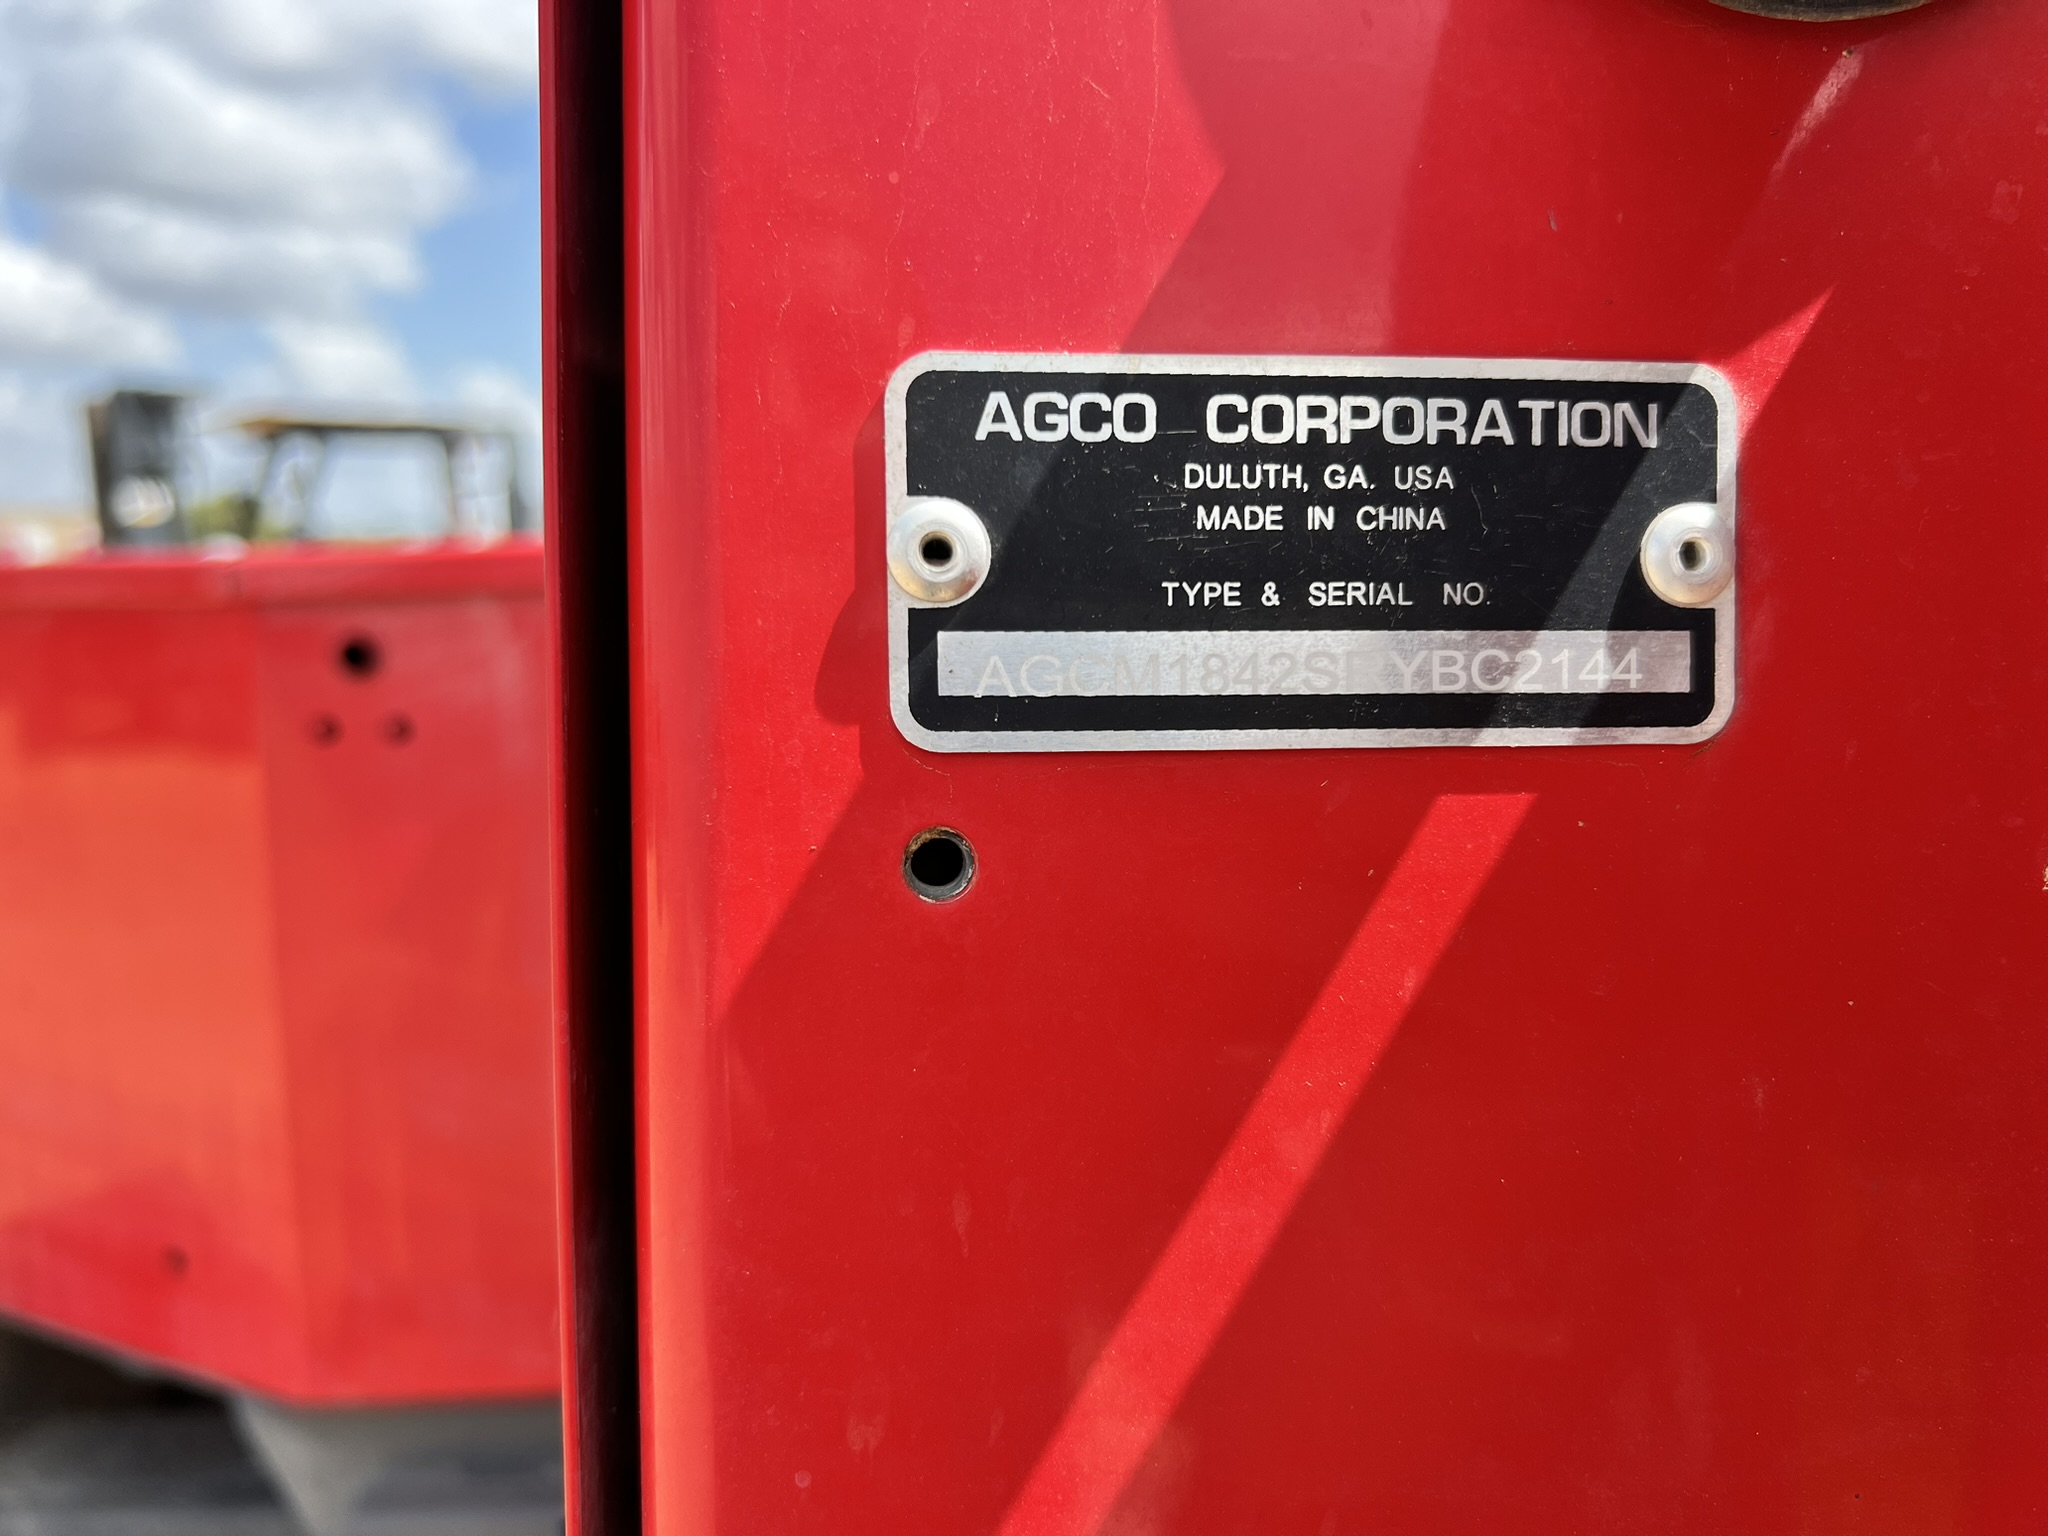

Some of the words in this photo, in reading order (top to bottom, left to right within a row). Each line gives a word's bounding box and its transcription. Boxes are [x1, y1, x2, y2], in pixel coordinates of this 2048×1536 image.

[975, 391, 1157, 443] AGCO
[1206, 395, 1659, 448] CORPORATION
[1184, 464, 1309, 491] DULUTH,
[1324, 465, 1376, 490] GA.
[1394, 466, 1455, 490] USA
[1196, 506, 1284, 531] MADE
[1308, 507, 1335, 531] IN
[1356, 507, 1446, 532] CHINA
[1162, 582, 1242, 607] TYPE
[1260, 582, 1280, 607] &
[1308, 582, 1414, 607] SERIAL
[1442, 583, 1491, 607] NO.
